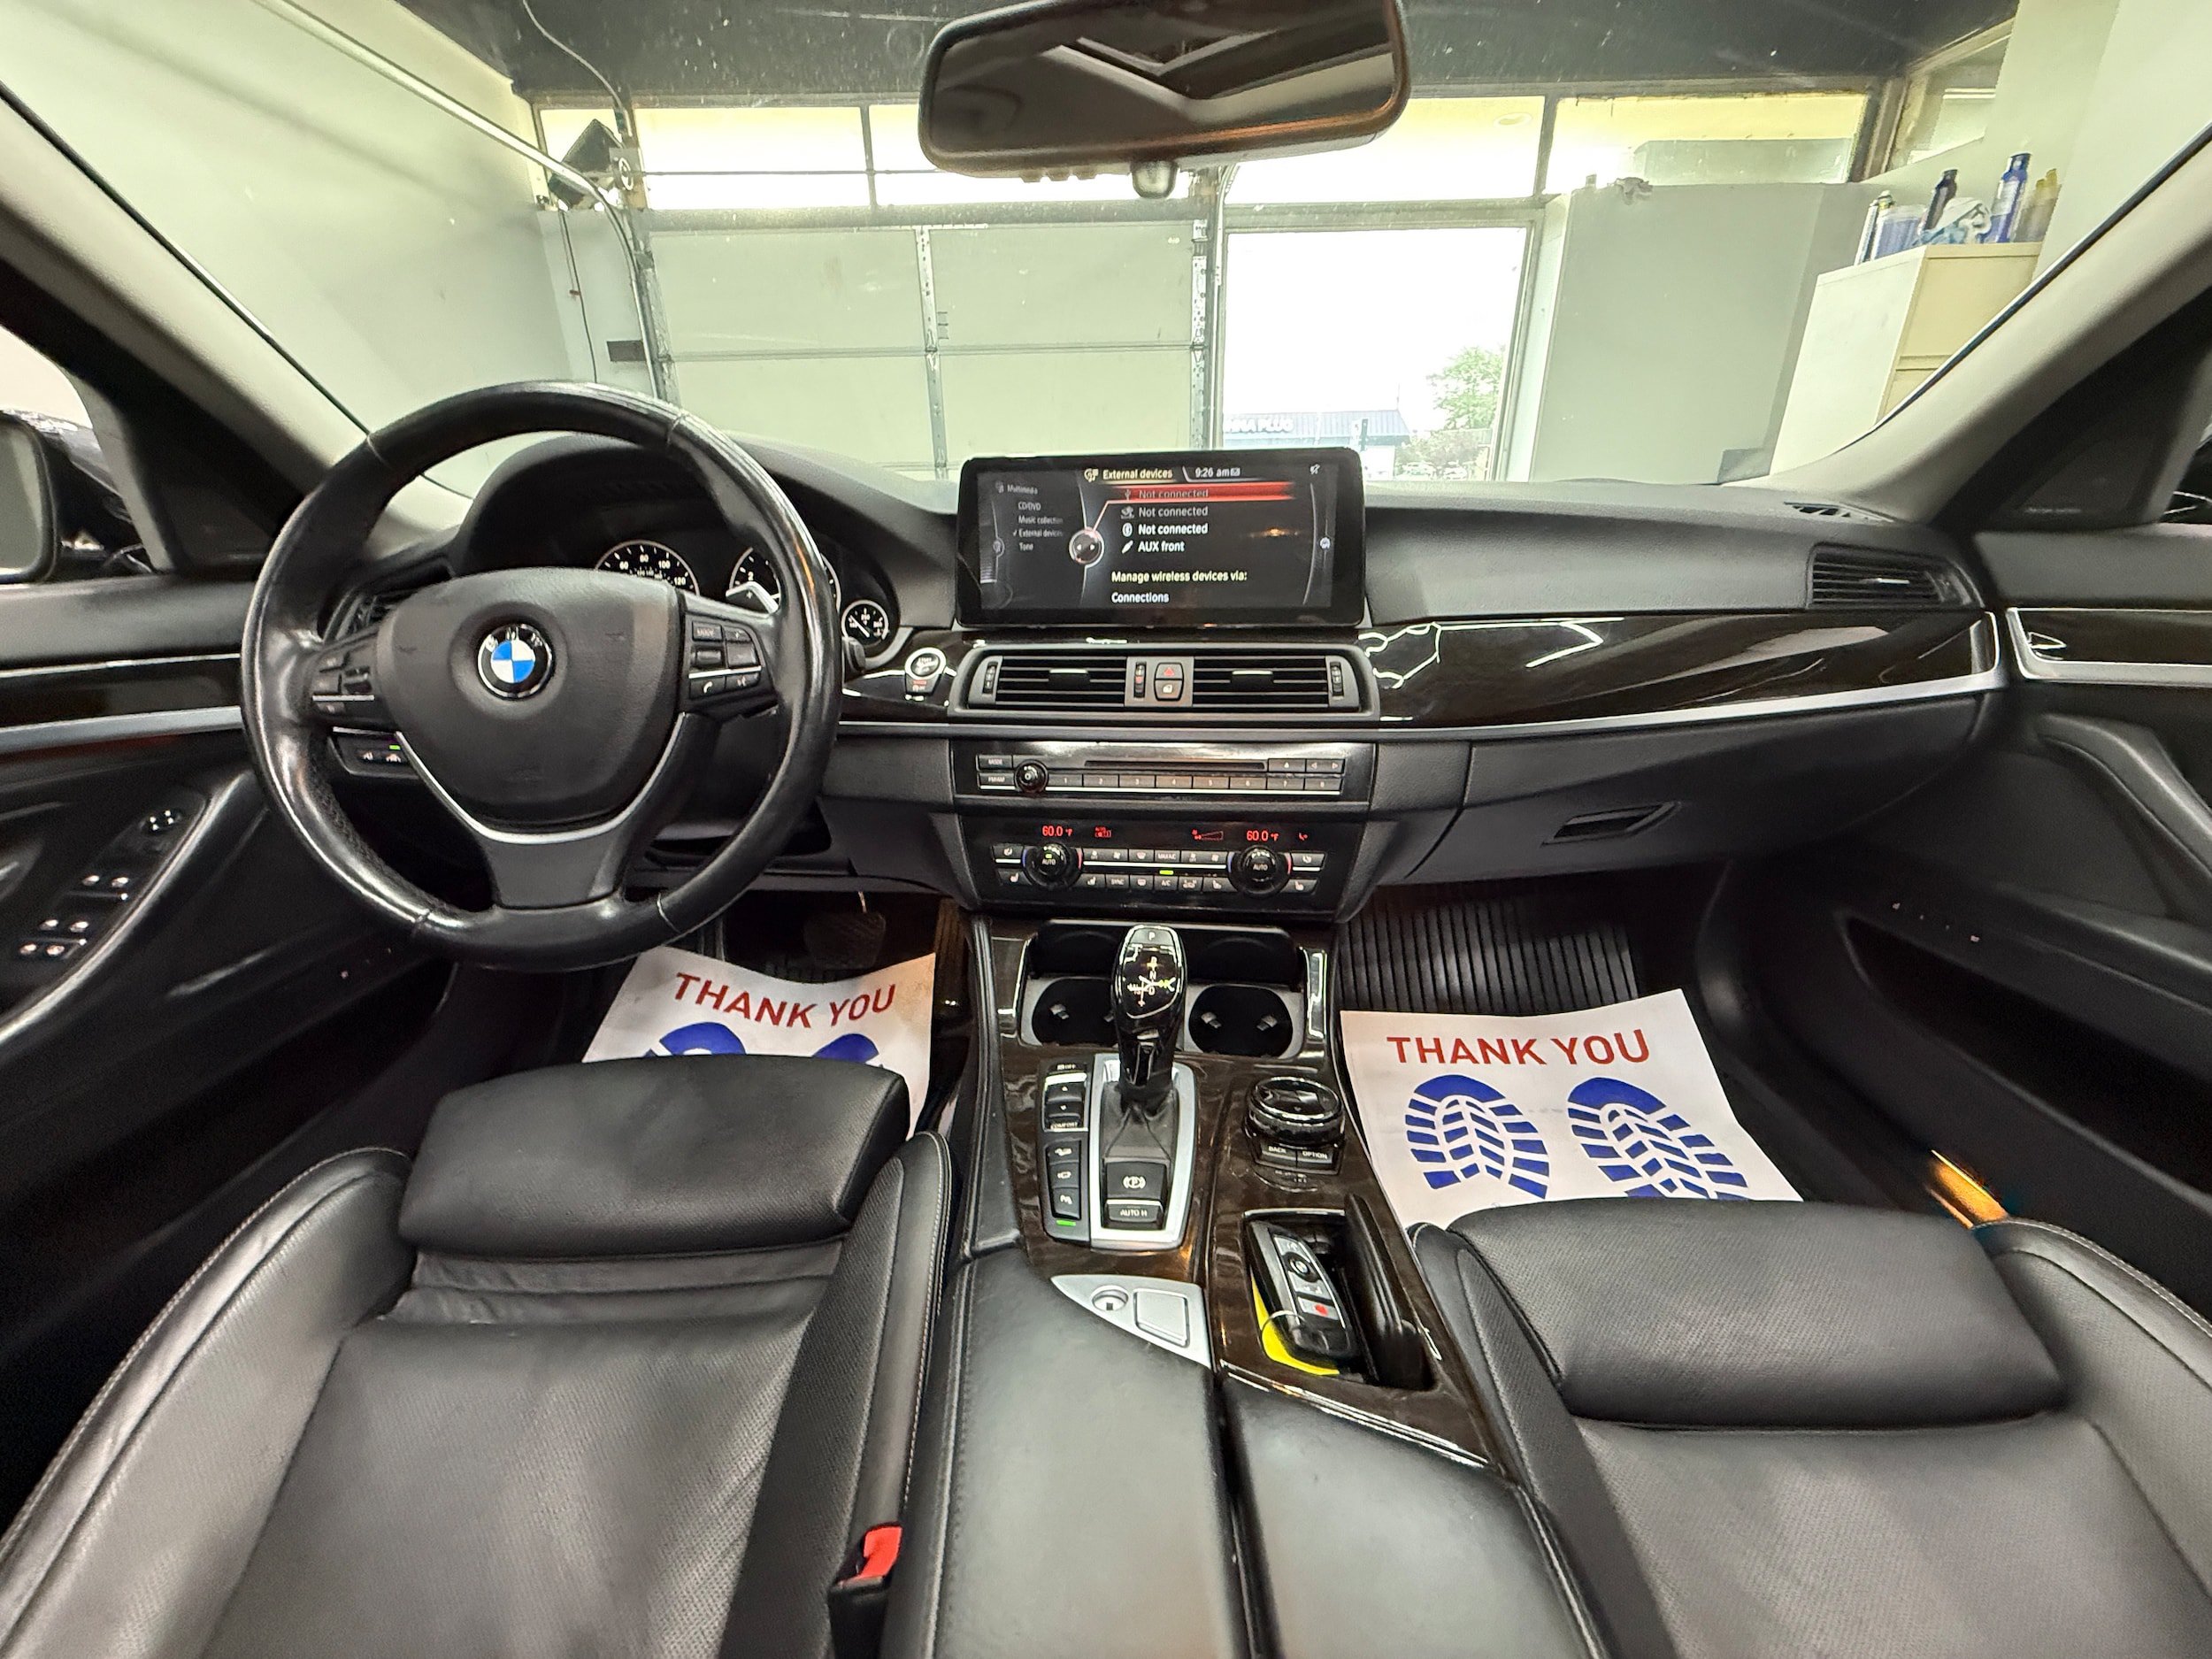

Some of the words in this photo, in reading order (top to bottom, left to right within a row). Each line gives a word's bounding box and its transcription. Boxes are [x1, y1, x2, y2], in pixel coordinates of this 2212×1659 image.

[1102, 469, 1139, 480] External
[1141, 468, 1173, 479] devices
[1194, 467, 1214, 478] 9:26
[1216, 468, 1230, 477] am
[1139, 490, 1156, 499] Not
[1158, 488, 1209, 498] connected
[1138, 507, 1156, 518] Not
[1157, 506, 1209, 517] connected
[1018, 515, 1036, 524] Music
[1018, 528, 1042, 538] External
[1138, 524, 1156, 535] Not
[1157, 523, 1209, 534] connected
[1137, 541, 1159, 552] AUX
[1161, 541, 1185, 552] front
[658, 560, 671, 569] 100
[673, 576, 686, 586] 120
[1111, 572, 1149, 585] Manage
[1150, 571, 1190, 581] wireless
[1192, 571, 1229, 582] devices
[1230, 571, 1248, 581] via:
[1111, 592, 1170, 603] Connections
[1041, 826, 1063, 837] 60.0
[1246, 830, 1269, 841] 60.0
[1148, 932, 1156, 941] P
[675, 972, 819, 1029] THANK
[827, 983, 896, 1027] YOU
[1386, 1036, 1547, 1065] THANK
[1549, 1028, 1650, 1065] YOU
[1268, 1145, 1286, 1154] BACK
[1302, 1150, 1328, 1160] OPTION
